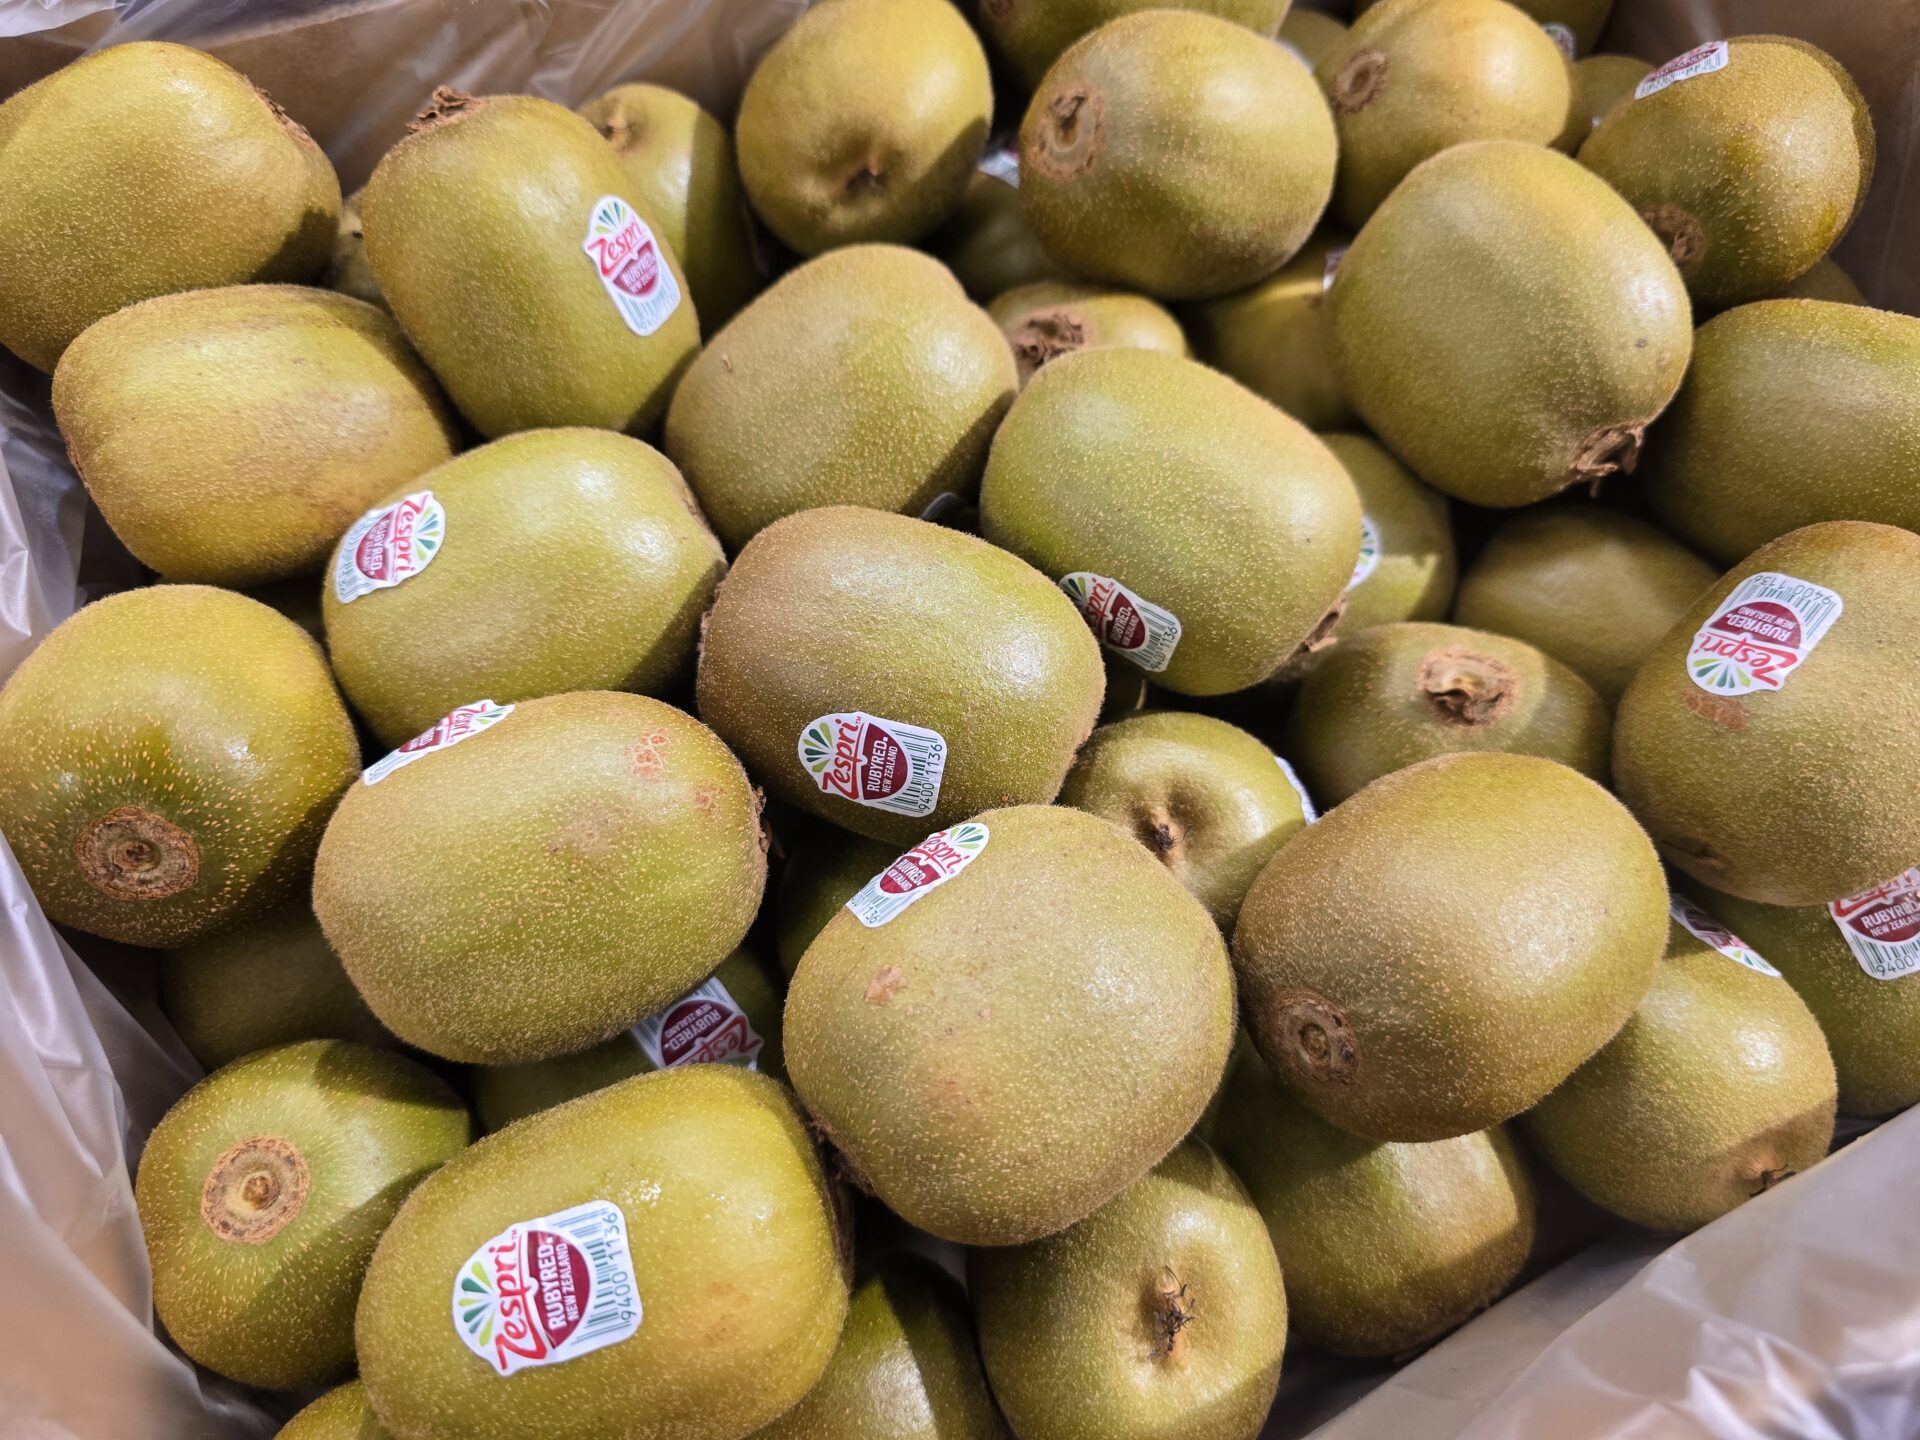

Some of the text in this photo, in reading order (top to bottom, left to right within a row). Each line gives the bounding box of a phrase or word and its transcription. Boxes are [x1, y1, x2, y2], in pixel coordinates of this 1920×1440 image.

[587, 215, 645, 277] Zespri
[370, 519, 390, 572] RUBYRED
[390, 493, 430, 575] Zespri
[1752, 575, 1832, 606] 9400 1136
[1160, 626, 1178, 648] 1136
[1737, 606, 1796, 631] NEW ZEALAND
[1693, 633, 1798, 687] Zespri
[821, 718, 864, 800] Zespri
[881, 745, 898, 794] NEW ZEALAND
[917, 742, 943, 811] 9400 1136
[1870, 925, 1889, 937] NEW
[1875, 954, 1915, 977] 9400
[664, 1002, 713, 1039] NEW ZEALAND
[688, 1014, 763, 1063] Zesp
[555, 1242, 580, 1322] NEW ZEALAND
[602, 1212, 637, 1321] 9400 1136
[488, 1245, 548, 1371] Zespri
